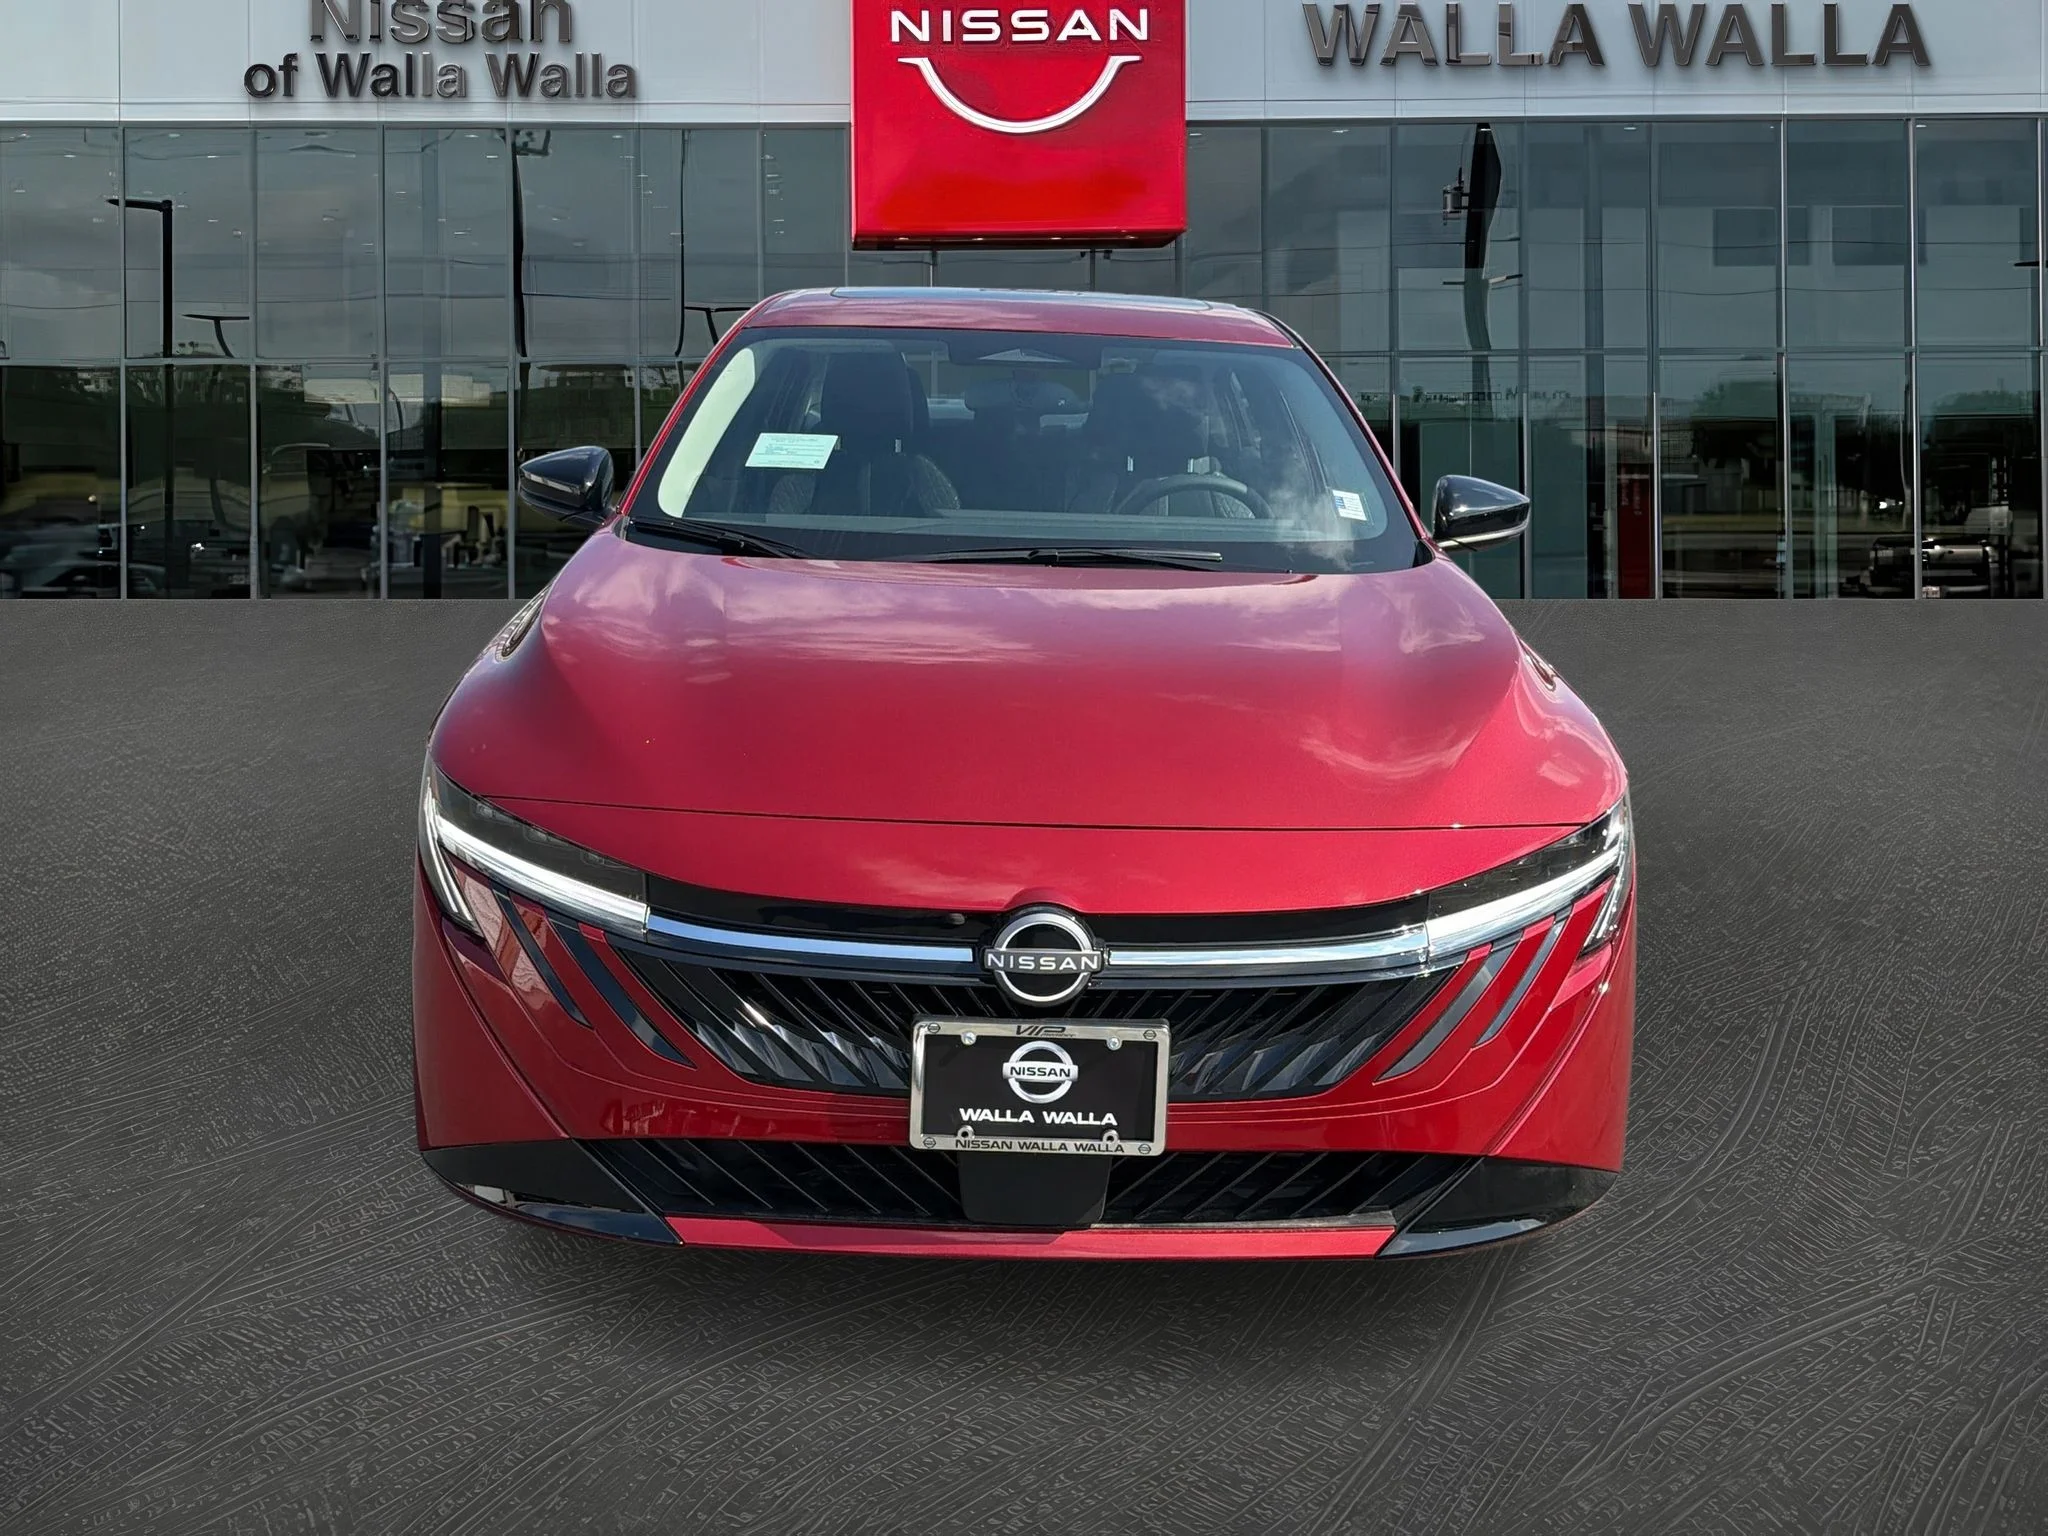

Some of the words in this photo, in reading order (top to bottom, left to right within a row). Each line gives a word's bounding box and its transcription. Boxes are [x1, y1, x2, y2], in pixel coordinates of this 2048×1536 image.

[310, 0, 572, 43] Nissan
[891, 8, 1148, 42] NISSAN
[1304, 3, 1606, 67] WALLA
[1627, 3, 1931, 67] WALLA
[243, 53, 298, 98] of
[314, 51, 467, 98] Walla
[485, 51, 637, 98] Walla
[987, 952, 1099, 971] NISSAN
[1016, 1025, 1066, 1036] VIP
[1009, 1066, 1071, 1078] NISSAN
[959, 1108, 1035, 1124] WALLA
[1042, 1111, 1118, 1126] WALLA
[955, 1139, 1013, 1150] NISSAN
[1018, 1141, 1068, 1152] WALLA
[1074, 1143, 1125, 1153] WALLA
